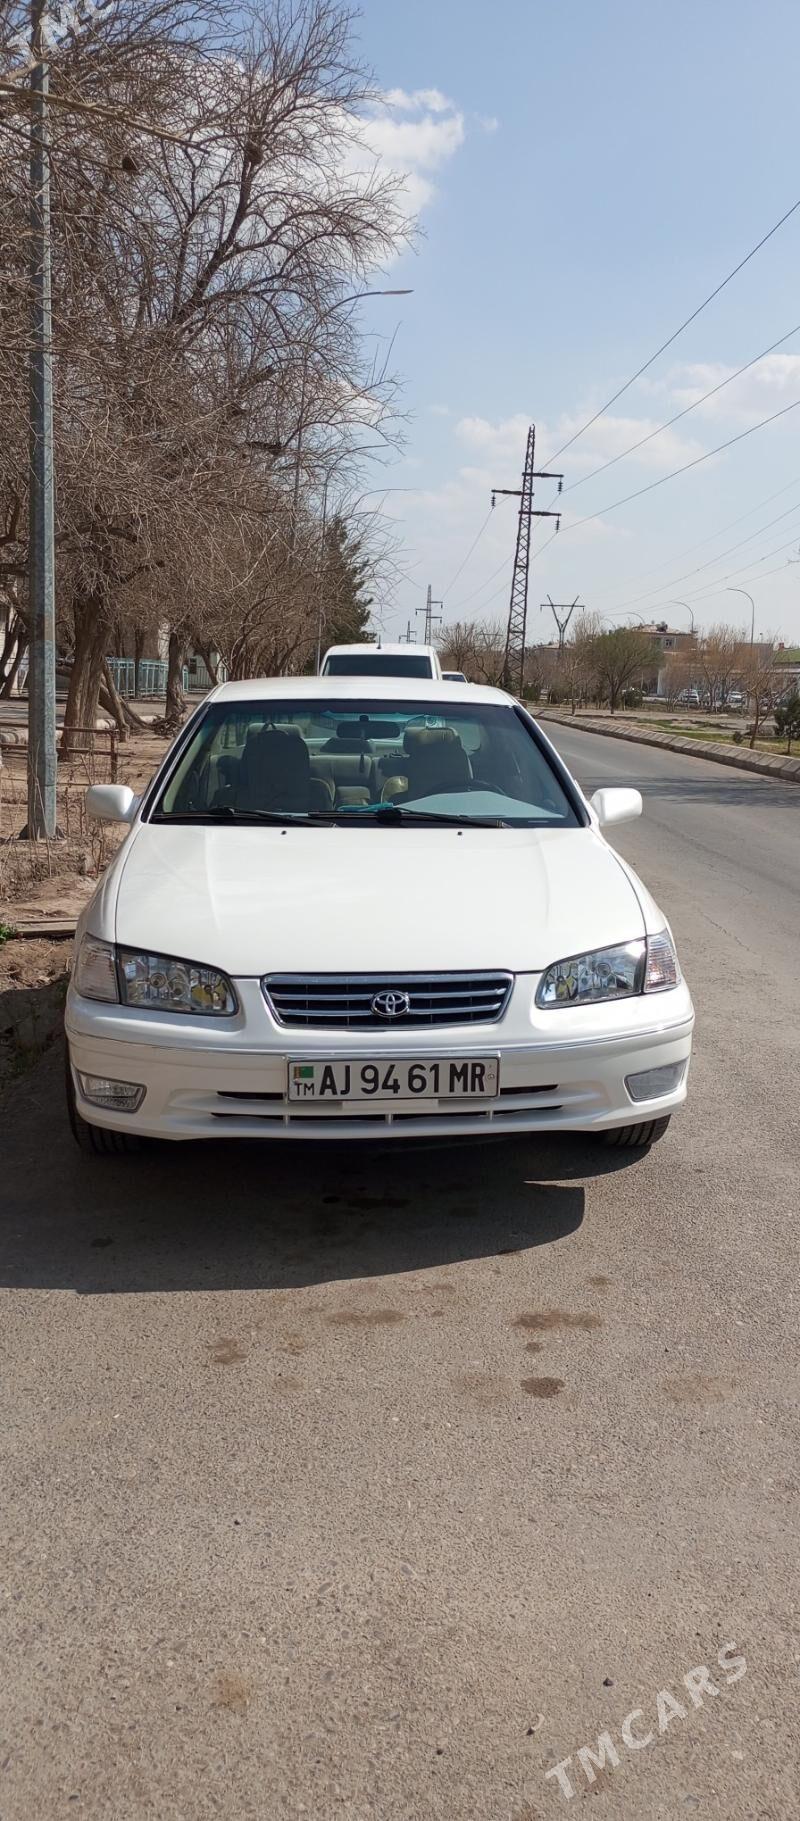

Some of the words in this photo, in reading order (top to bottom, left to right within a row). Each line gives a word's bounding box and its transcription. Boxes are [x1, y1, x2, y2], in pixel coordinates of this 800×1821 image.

[295, 1082, 315, 1096] TM
[319, 1065, 351, 1096] AJ
[360, 1064, 400, 1095] 94
[408, 1063, 439, 1093] 61
[449, 1062, 486, 1092] MR
